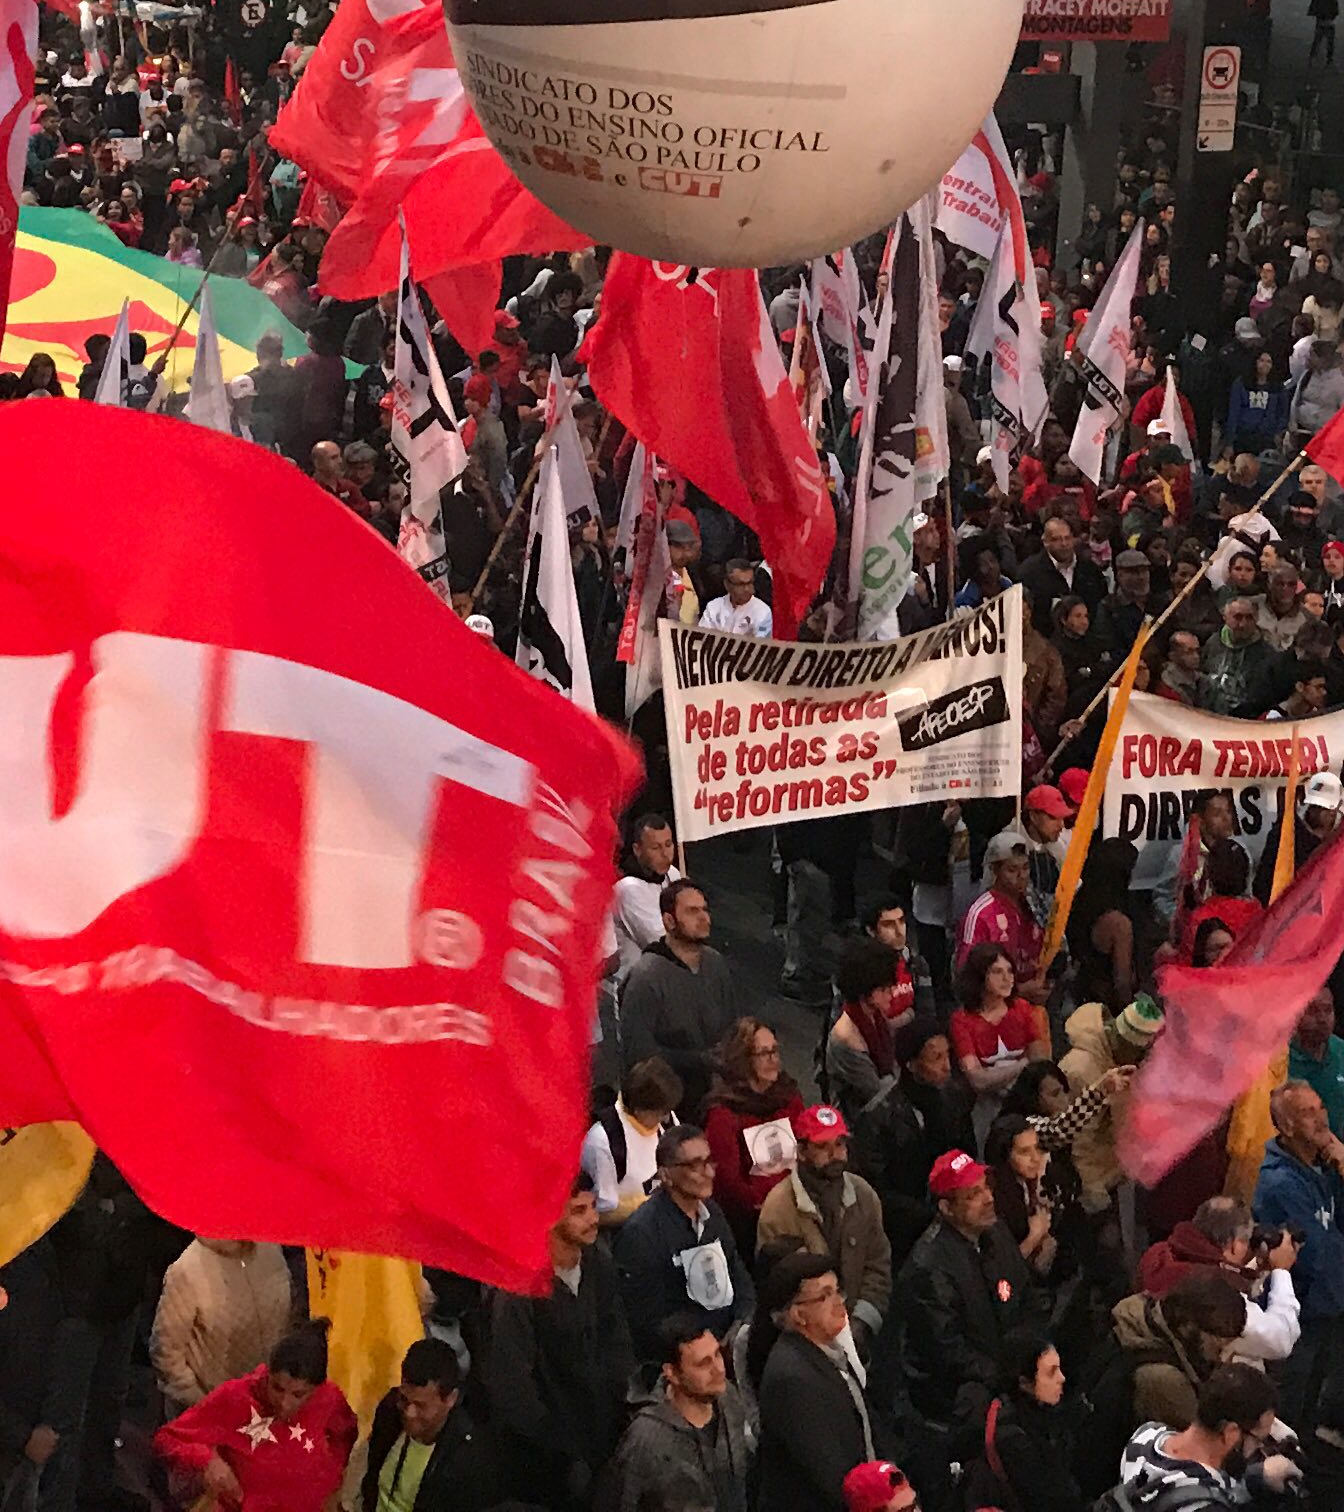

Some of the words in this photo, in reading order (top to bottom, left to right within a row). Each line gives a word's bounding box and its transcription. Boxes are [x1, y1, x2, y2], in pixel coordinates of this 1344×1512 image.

[1022, 16, 1134, 36] MONTAGENS
[466, 50, 597, 106] SINDICATO
[608, 89, 673, 116] DOS
[522, 99, 559, 124] DO
[569, 108, 683, 143] ENSINO
[693, 126, 830, 153] OFICIAL
[544, 126, 581, 150] DE
[586, 133, 647, 164] SÃO
[657, 146, 761, 173] PAULO
[638, 167, 723, 199] CUT
[943, 174, 996, 209] entral
[670, 628, 795, 689] NENHUM
[789, 642, 895, 689] DIREITO
[892, 643, 912, 674] A
[686, 699, 739, 743] Pela
[748, 689, 888, 733] retirada
[911, 685, 994, 743] APEOESP
[698, 744, 726, 784] de
[735, 733, 826, 775] todas
[836, 731, 880, 763] as
[1122, 734, 1202, 779] FORA
[1213, 735, 1330, 778] TEMER!
